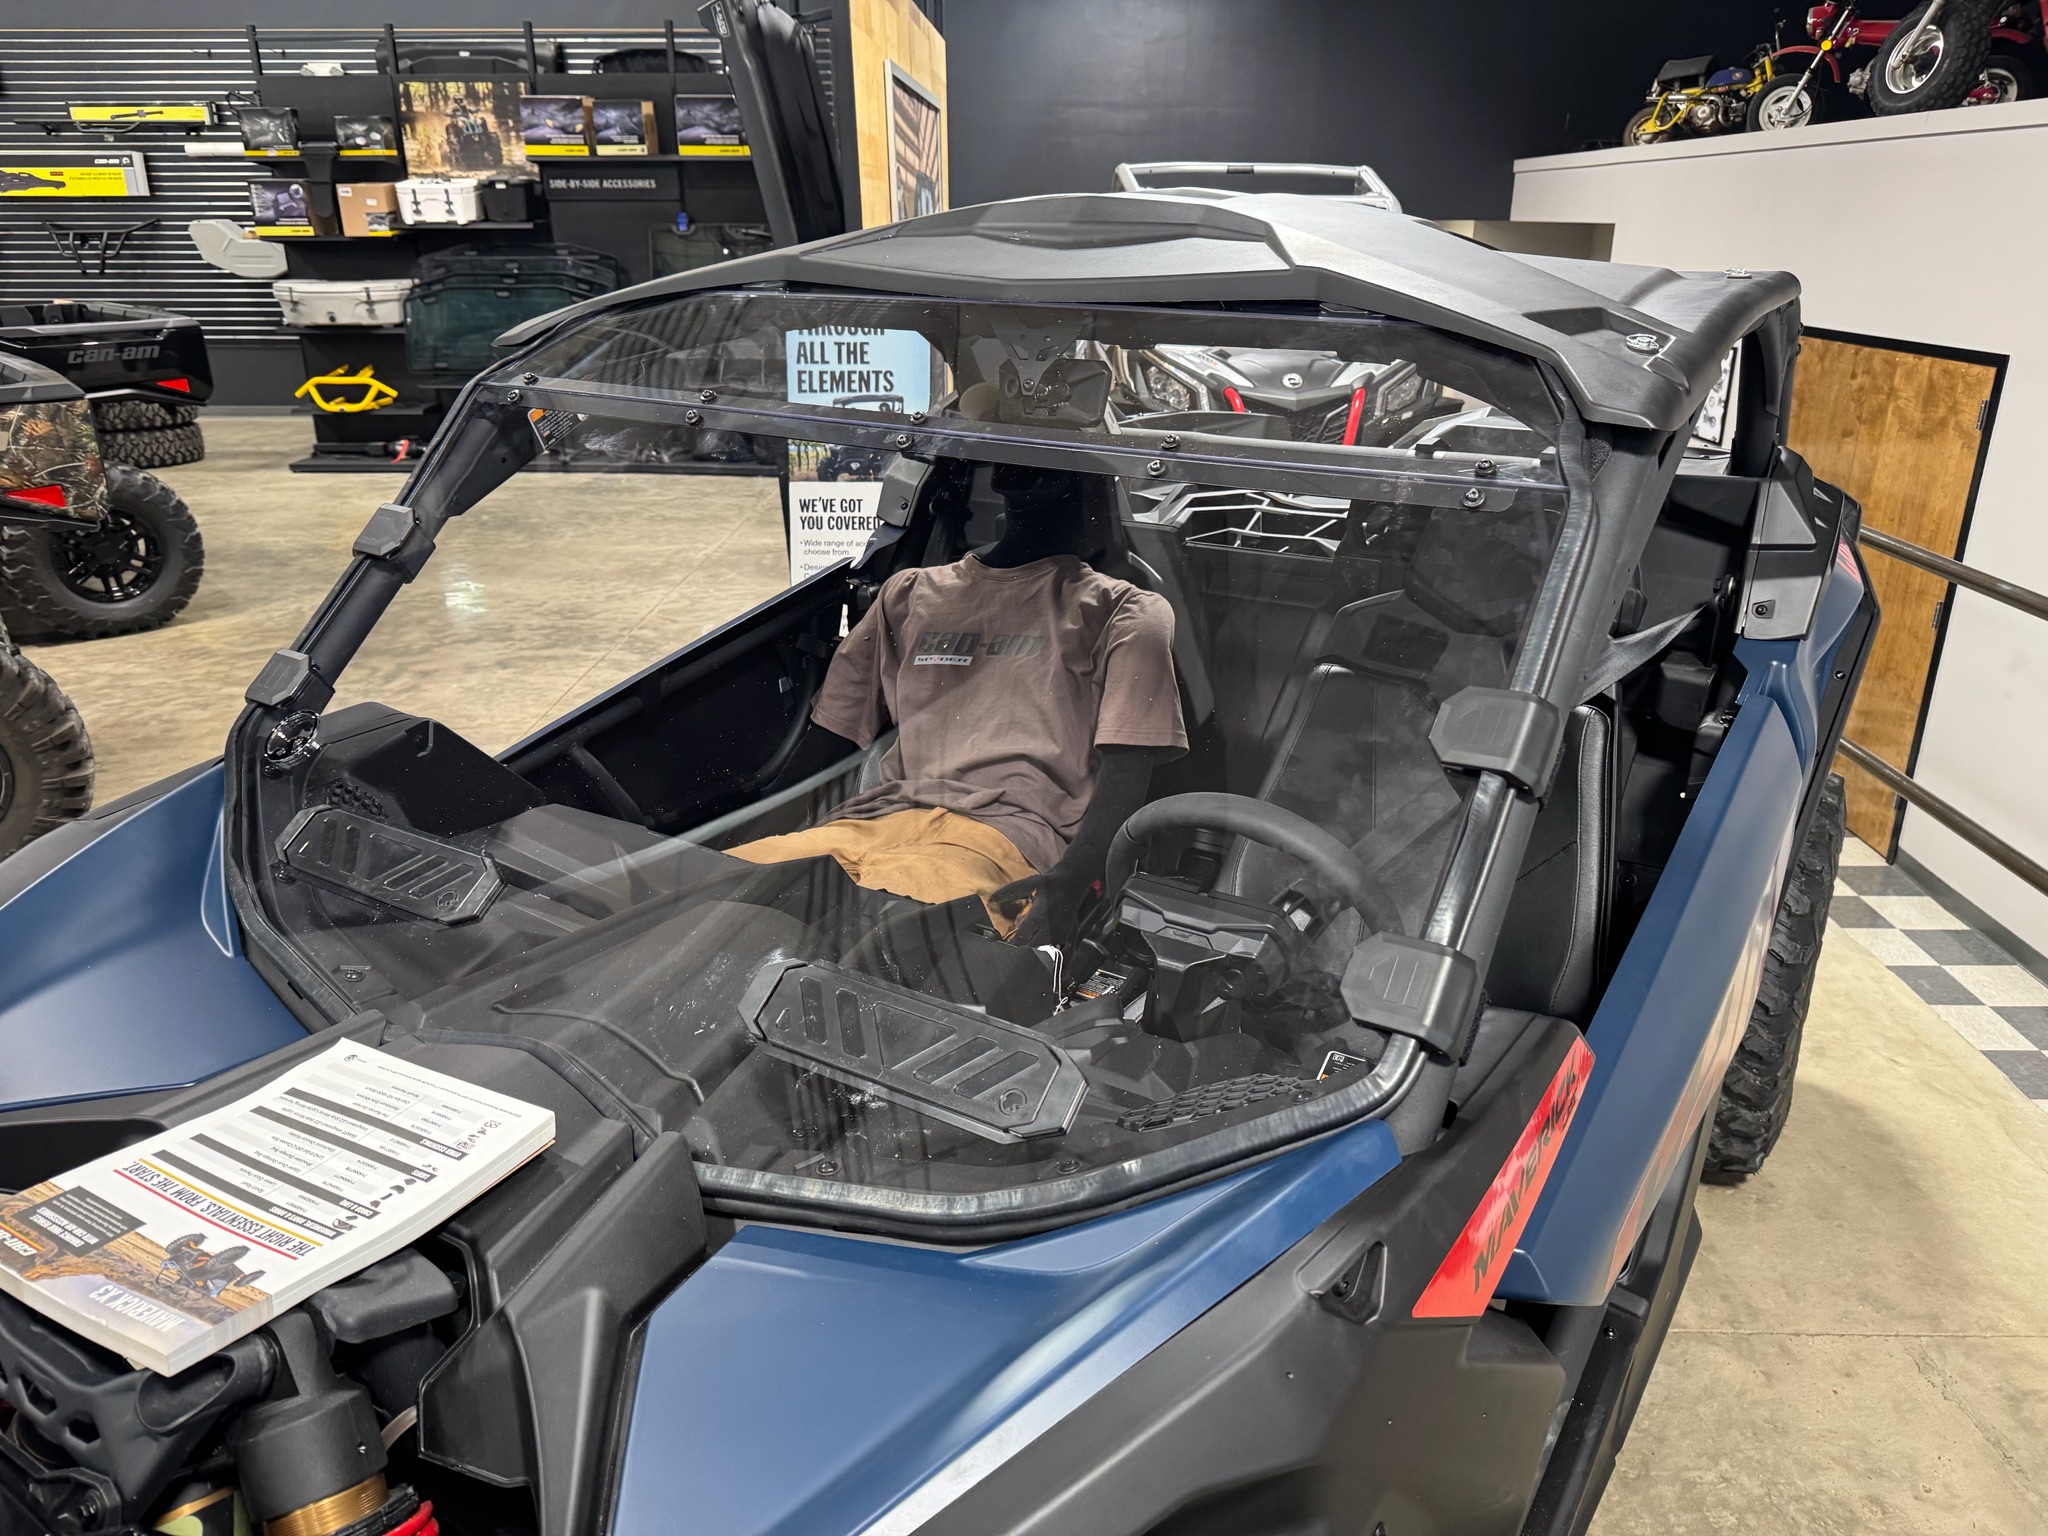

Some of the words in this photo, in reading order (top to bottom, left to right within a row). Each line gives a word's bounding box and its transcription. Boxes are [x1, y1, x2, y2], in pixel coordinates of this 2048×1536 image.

[549, 178, 601, 189] SIDE-BY-SIDE
[602, 178, 656, 189] ACCESSORIES
[67, 345, 160, 364] can-am
[796, 341, 829, 364] ALL
[834, 341, 870, 364] THE
[797, 370, 894, 393] ELEMENTS
[799, 497, 836, 513] WE'VE
[840, 498, 863, 513] GOT
[800, 516, 823, 530] YOU
[917, 632, 1045, 656] can-am
[417, 1138, 449, 1152] ESSENTIALS
[259, 1154, 280, 1163] Storage
[276, 1149, 296, 1159] Storage
[442, 1148, 463, 1158] OTHER
[292, 1156, 314, 1166] Shoulder
[120, 1160, 162, 1183] START.
[286, 1165, 302, 1173] Upper
[409, 1169, 431, 1179] LIGHTS
[1473, 1048, 1578, 1294] MAVERICK
[150, 1176, 180, 1192] THE
[239, 1180, 253, 1188] Roof
[261, 1178, 277, 1186] Lower
[168, 1186, 207, 1207] FROM
[35, 1206, 70, 1226] ACCESSORIES
[267, 1206, 288, 1216] DOORS
[353, 1205, 374, 1216] CARGO
[28, 1213, 53, 1228] VEHICLE
[196, 1201, 265, 1235] ESSENTIALS.
[287, 1214, 307, 1224] ROOFS
[45, 1223, 65, 1234] YOUR
[63, 1222, 88, 1237] CAN-AM
[80, 1233, 100, 1244] WITH
[254, 1227, 295, 1247] RIGHT
[285, 1240, 316, 1256] THE
[104, 1292, 186, 1333] MAVERICK
